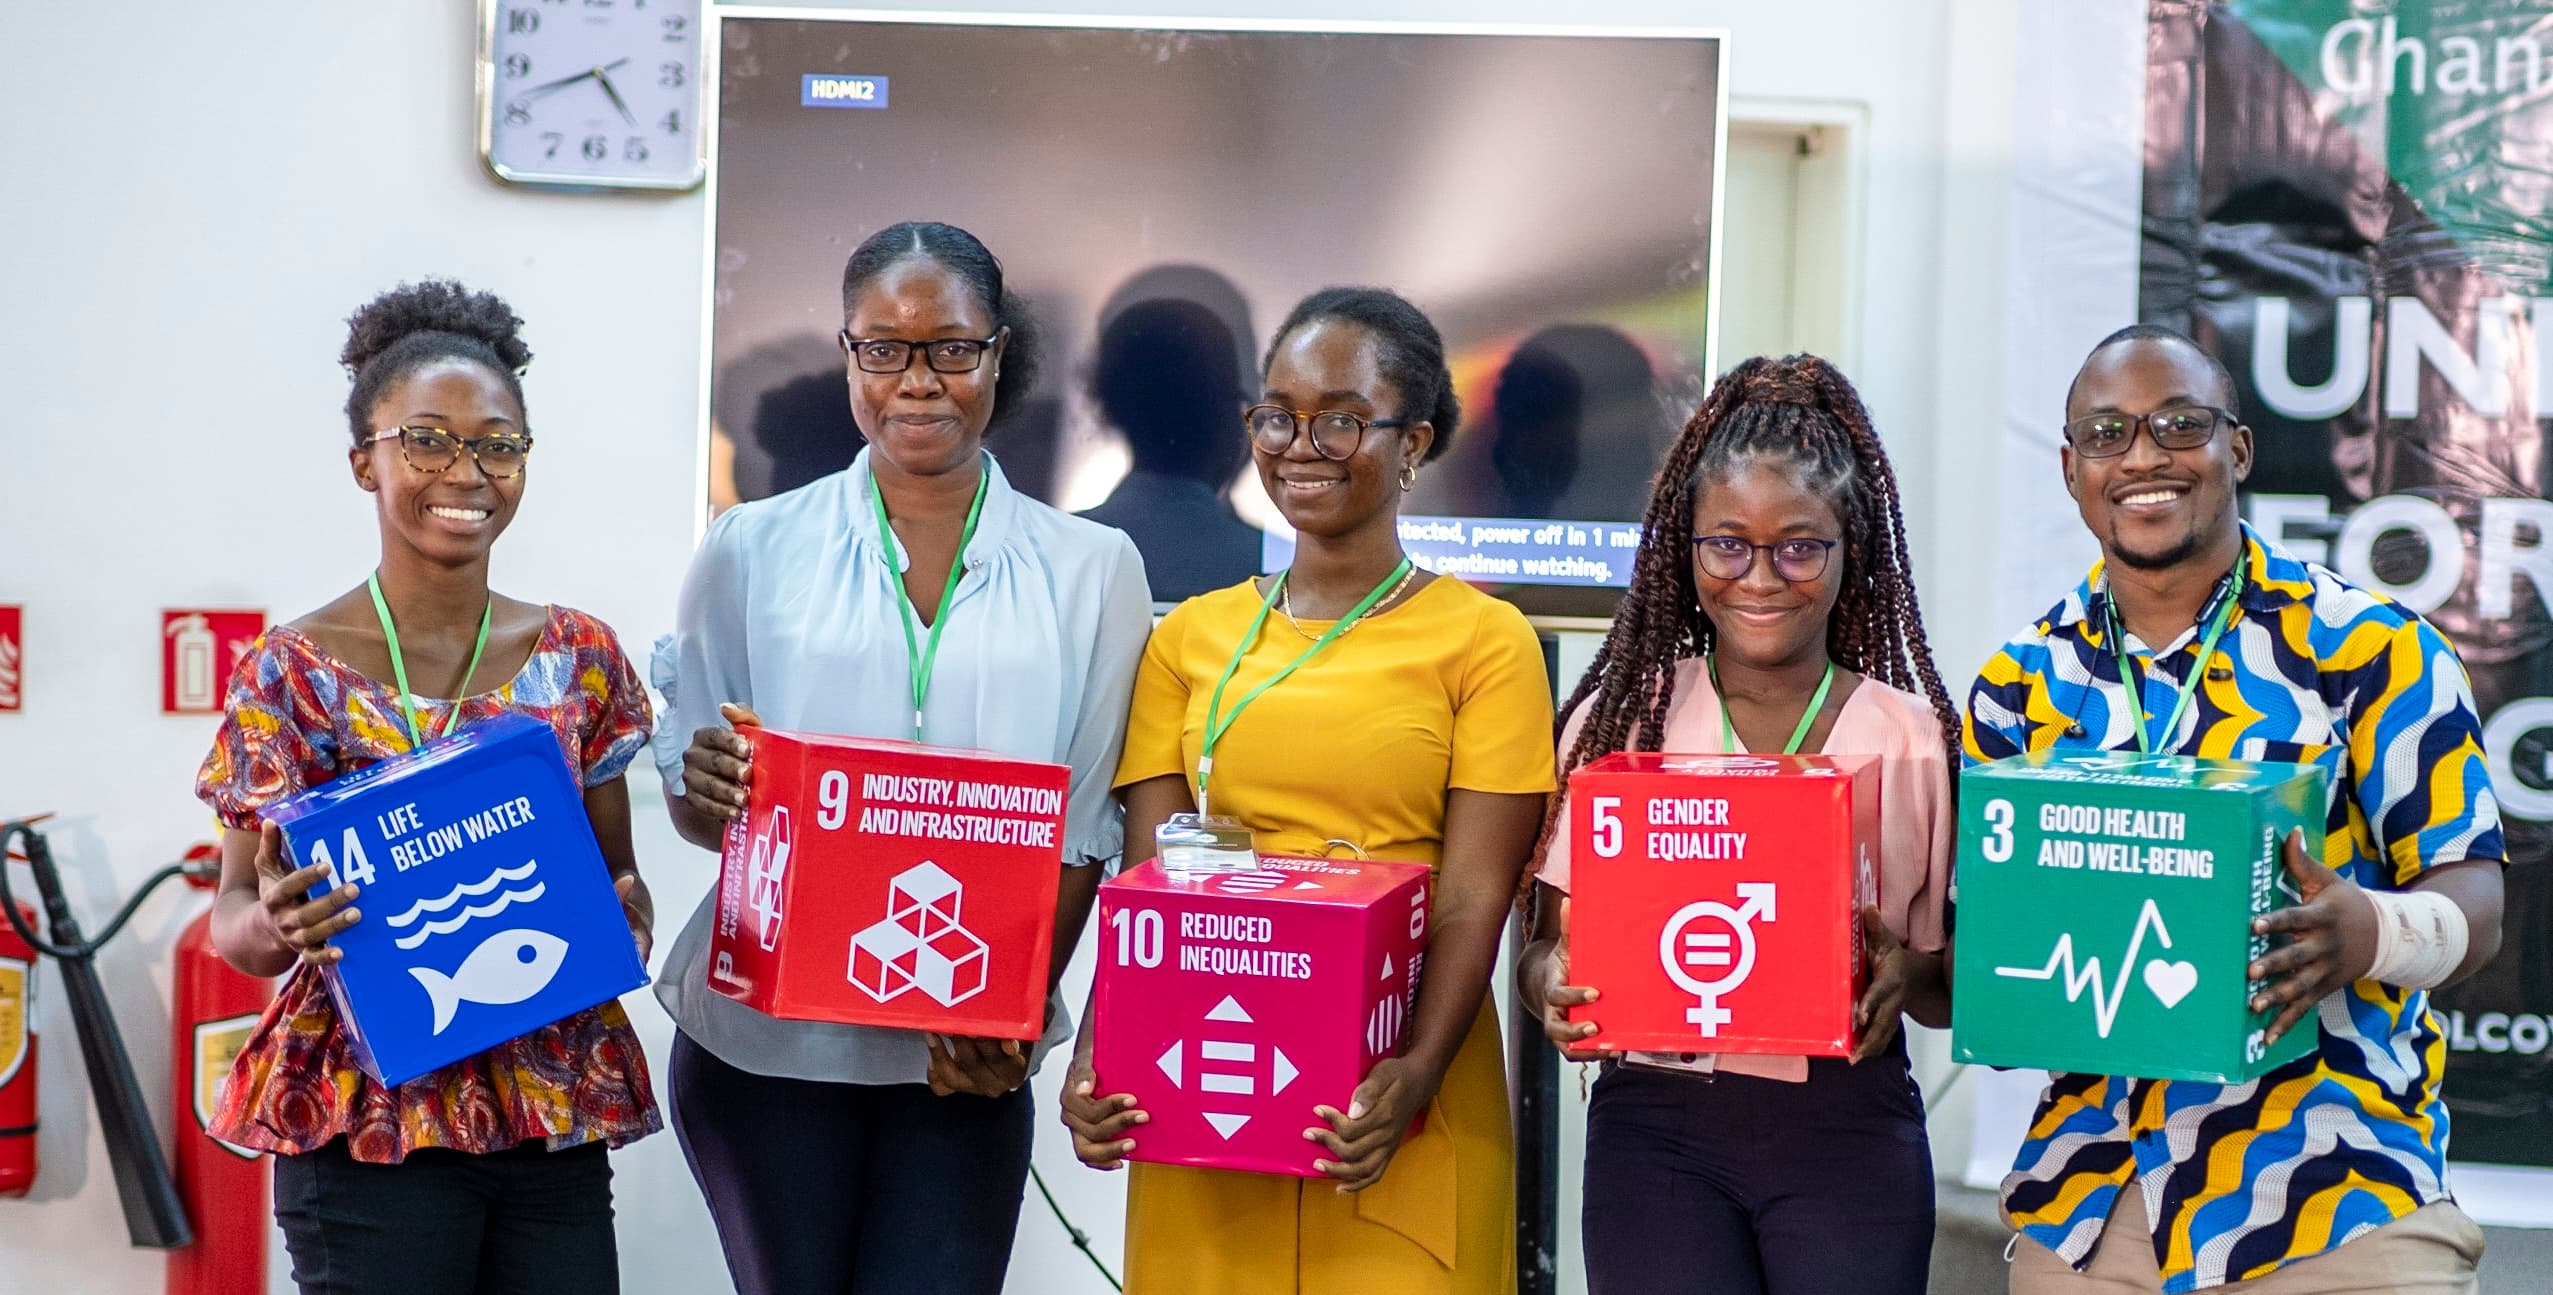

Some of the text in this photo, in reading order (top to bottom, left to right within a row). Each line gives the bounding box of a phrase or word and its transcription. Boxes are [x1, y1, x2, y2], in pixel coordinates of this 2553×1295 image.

[508, 8, 541, 34] 10
[504, 53, 532, 79] 9
[658, 61, 686, 88] 3
[811, 79, 875, 100] HDMI2
[503, 99, 532, 128] 8
[658, 109, 681, 134] 4
[541, 131, 564, 159] 7
[581, 134, 608, 161] 6
[623, 136, 649, 162] 5
[1472, 526, 1530, 547] power
[1534, 525, 1563, 546] off
[1567, 526, 1587, 546] in
[1592, 527, 1603, 546] 1
[1436, 555, 1518, 576] continue
[1523, 557, 1613, 583] watching.
[817, 770, 849, 831] 9
[862, 773, 1062, 816] INDUSTRY, INNOVATION
[377, 802, 424, 841] LIFE
[858, 807, 1056, 848] AND INFRASTRUCTURE
[1592, 796, 1623, 858] 5
[1648, 799, 1729, 826] GENDER
[2039, 803, 2186, 841] GOOD HEALTH
[390, 796, 536, 873] BELOW WATER
[1983, 797, 2015, 862] 3
[311, 827, 376, 892] 14
[1648, 833, 1747, 862] EQUALITY
[2037, 838, 2214, 879] AND WELL-BEING
[1180, 912, 1272, 944] REDUCED
[1410, 885, 1426, 940] 10
[1112, 907, 1164, 968] 10
[1180, 945, 1312, 979] INEQUALITIES
[2432, 1009, 2553, 1055] LCO
